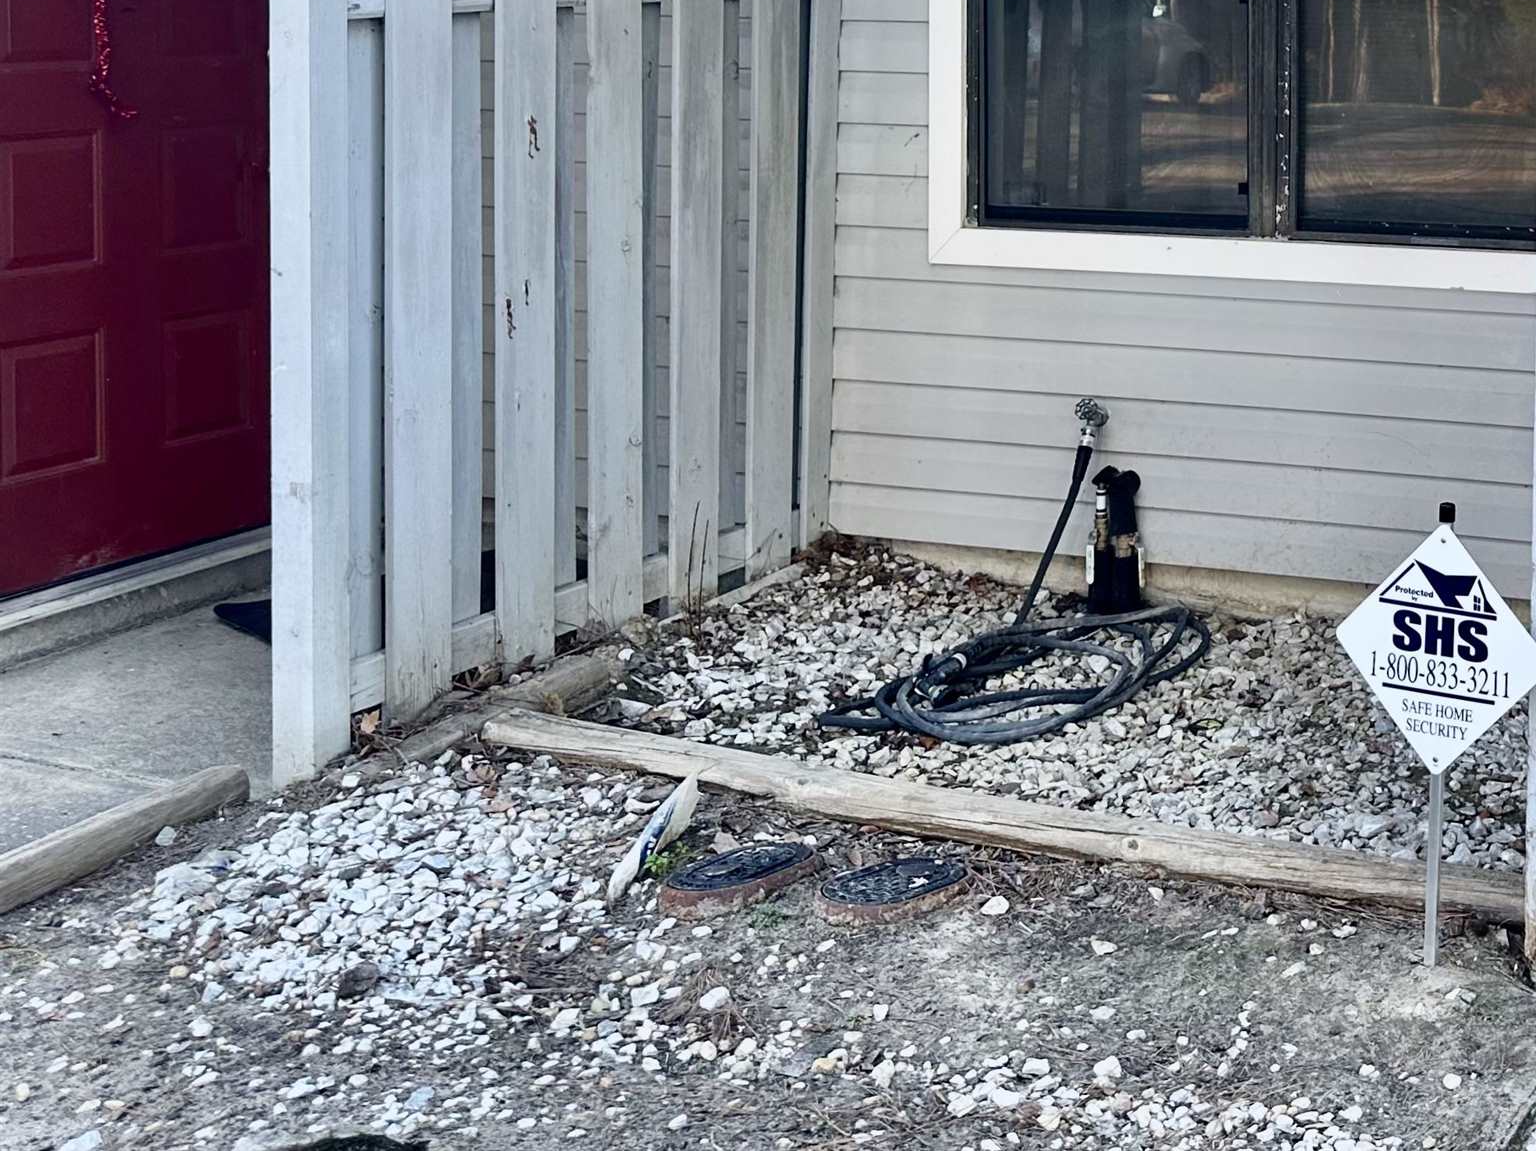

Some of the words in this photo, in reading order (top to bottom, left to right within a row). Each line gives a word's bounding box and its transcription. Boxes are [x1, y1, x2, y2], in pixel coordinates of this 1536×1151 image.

[1395, 585, 1434, 598] Protected
[1392, 609, 1488, 663] SHS
[1370, 651, 1510, 698] 1-800-833-3211
[1402, 698, 1432, 716] SAFE
[1435, 704, 1473, 723] HOME
[1406, 718, 1468, 741] SECURITY
